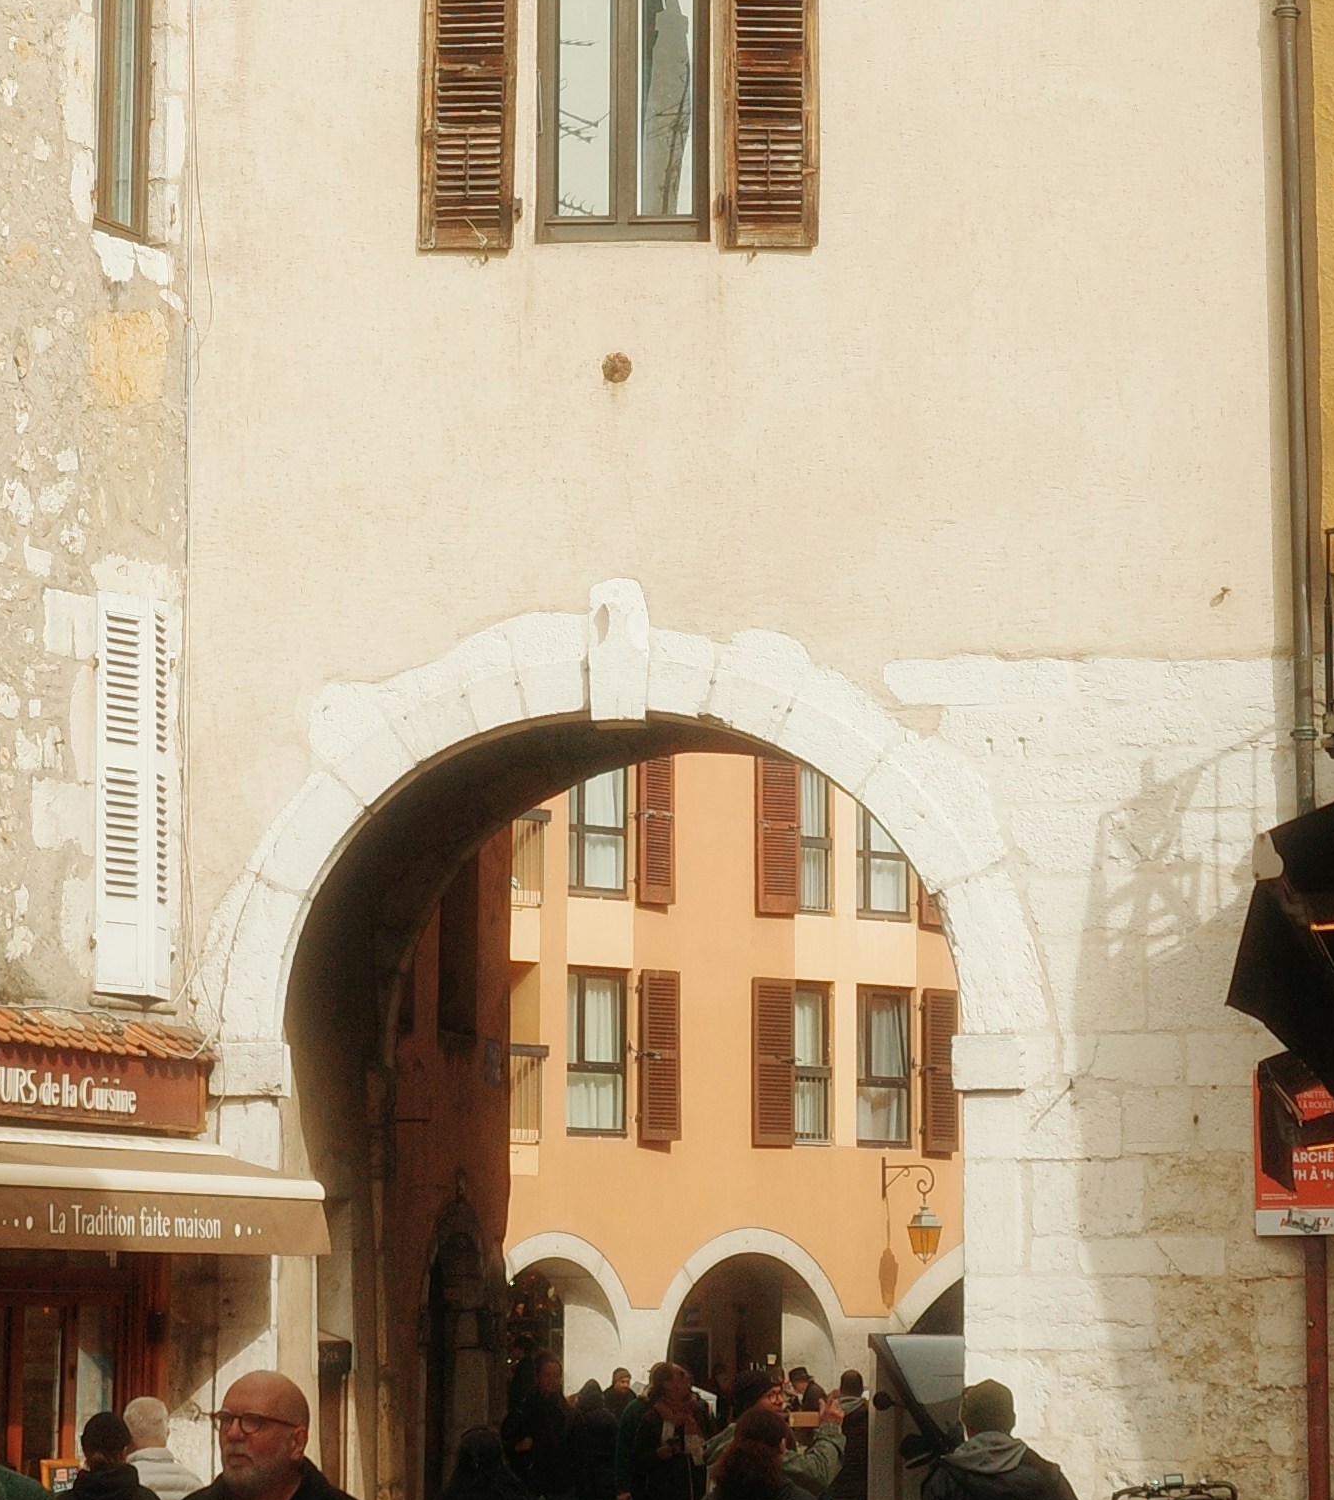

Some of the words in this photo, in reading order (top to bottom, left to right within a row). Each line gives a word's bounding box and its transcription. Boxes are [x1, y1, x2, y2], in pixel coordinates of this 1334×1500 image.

[38, 1072, 61, 1107] de
[62, 1073, 79, 1108] la
[79, 1076, 138, 1114] Cuisine
[1292, 1148, 1334, 1164] ARCHÉ
[1309, 1166, 1319, 1182] À
[48, 1202, 66, 1235] La
[71, 1203, 136, 1237] Tradition
[139, 1206, 171, 1238] faite
[174, 1208, 222, 1240] maison
